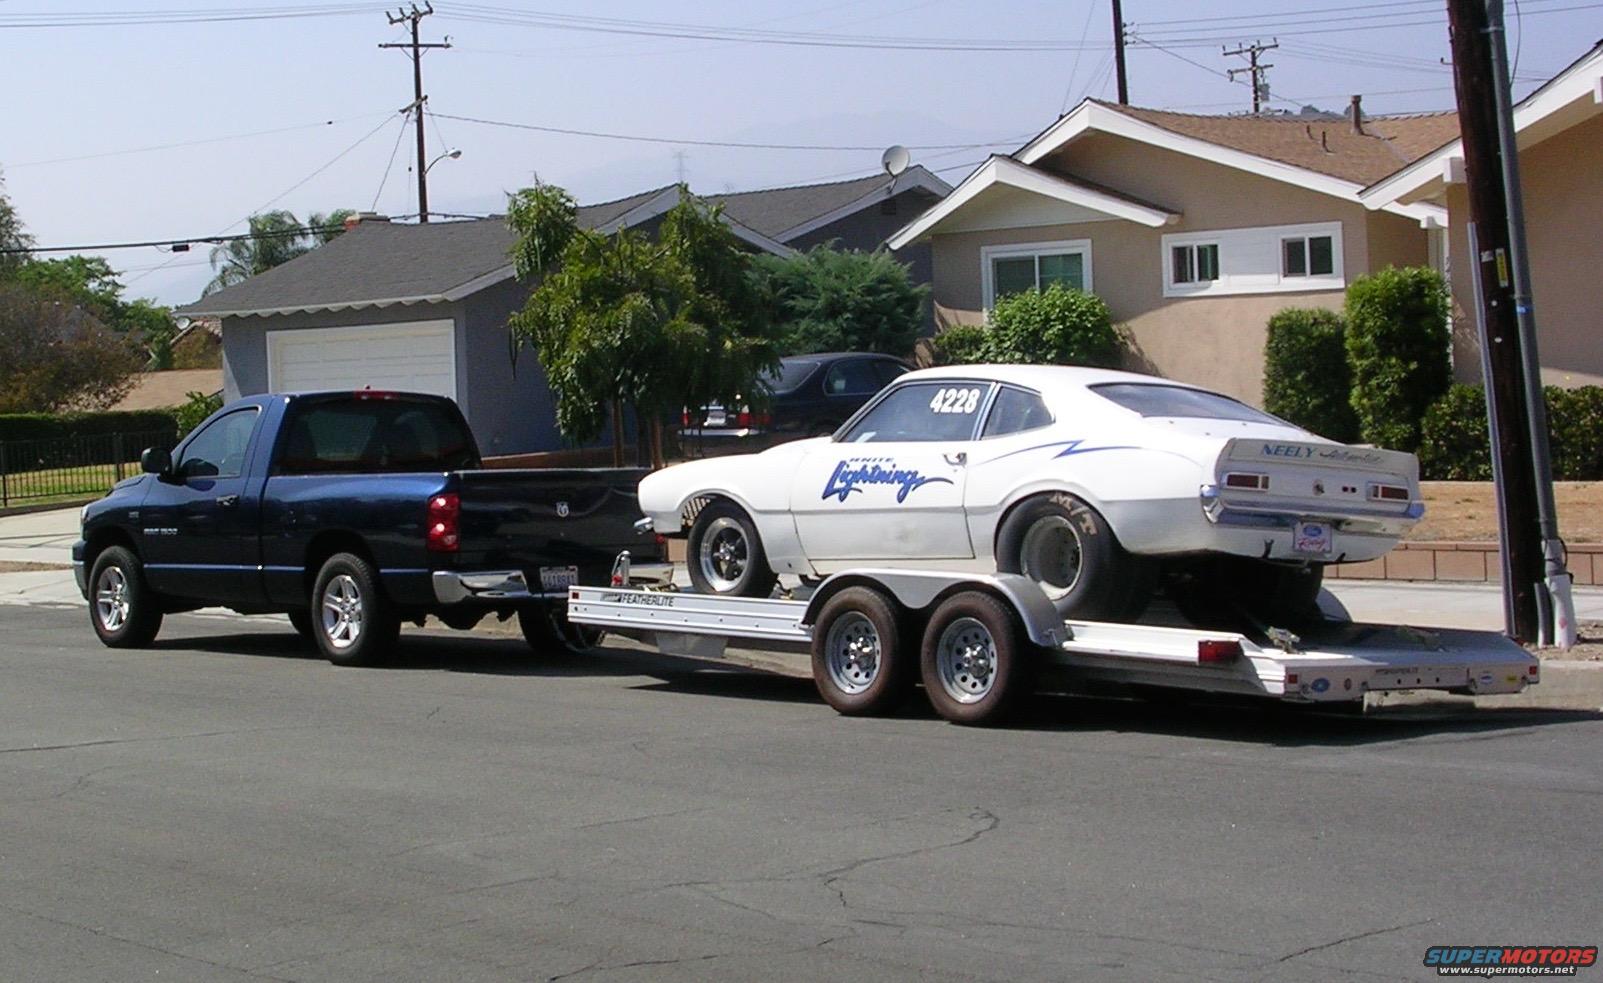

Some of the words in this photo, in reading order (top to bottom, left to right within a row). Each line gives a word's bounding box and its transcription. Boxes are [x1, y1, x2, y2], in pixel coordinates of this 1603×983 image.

[929, 388, 980, 414] 4228
[1262, 443, 1316, 458] NEELY
[821, 459, 954, 504] Lightning
[621, 592, 674, 608] FEATHERLITE
